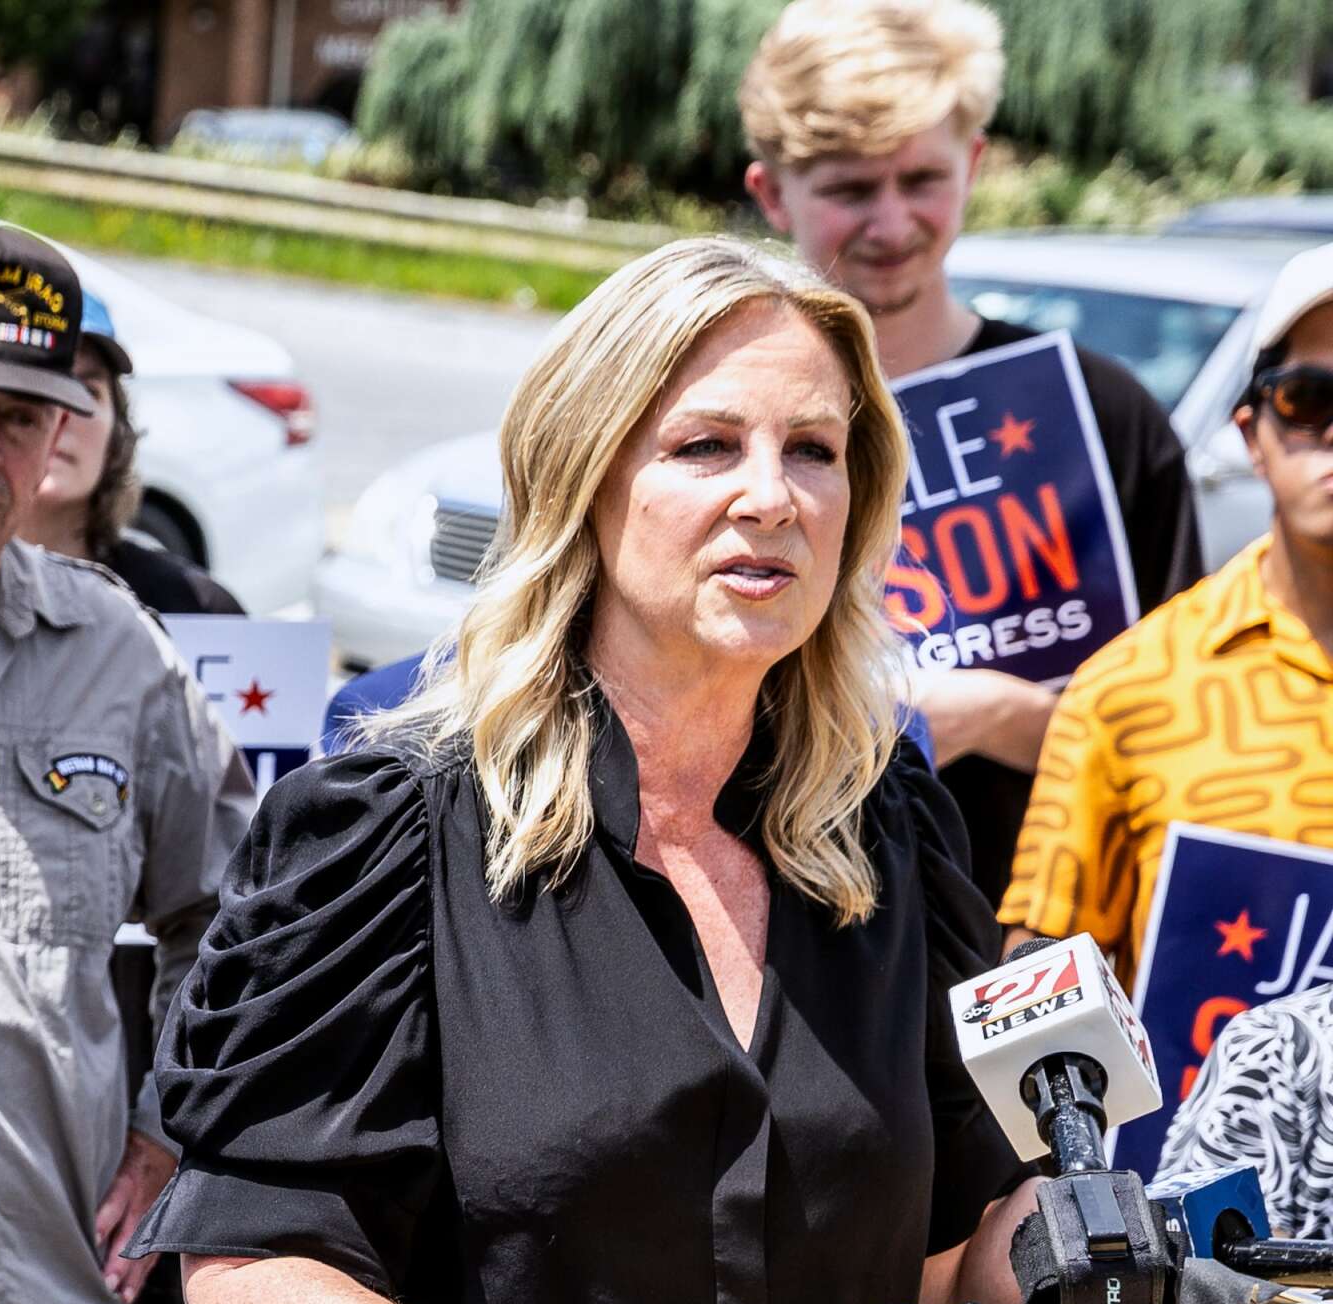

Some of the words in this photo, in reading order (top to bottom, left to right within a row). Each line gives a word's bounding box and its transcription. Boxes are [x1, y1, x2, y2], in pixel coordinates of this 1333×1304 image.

[32, 311, 69, 332] STORM
[984, 951, 1072, 1020] 27
[962, 1003, 993, 1021] abc
[985, 989, 1081, 1038] NEWS
